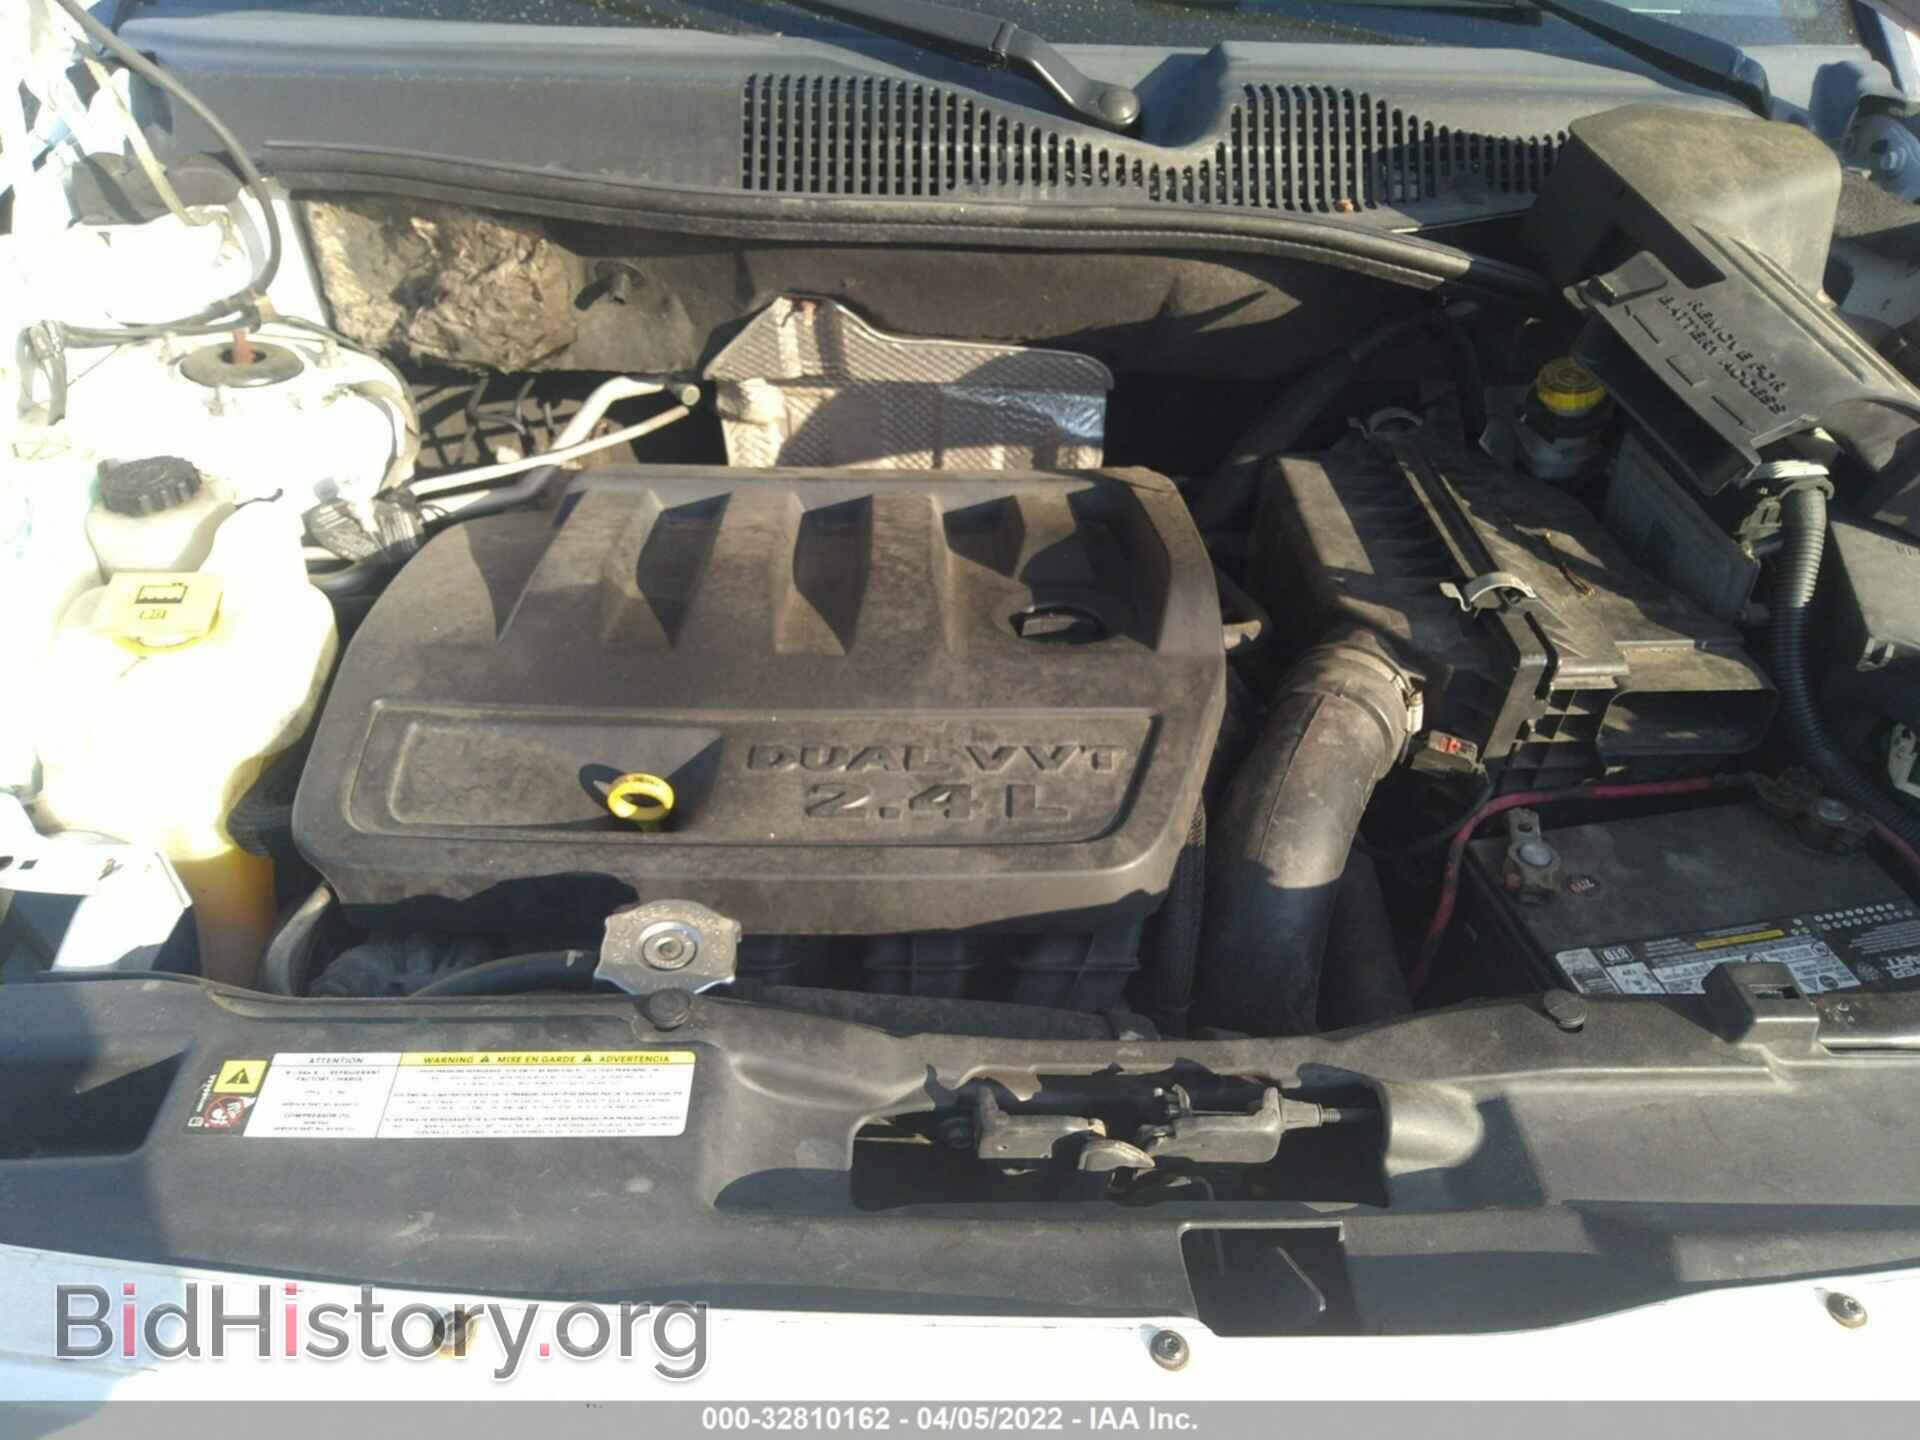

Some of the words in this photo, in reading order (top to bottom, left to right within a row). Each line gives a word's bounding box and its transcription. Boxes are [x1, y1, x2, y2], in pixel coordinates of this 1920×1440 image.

[746, 744, 953, 772] DUAL
[964, 744, 1128, 772] VVT
[309, 1056, 365, 1064] ATTENTION
[423, 1056, 474, 1064] WARNING
[497, 1056, 522, 1064] MISE
[542, 1055, 577, 1063] GARDE
[600, 1055, 671, 1063] ADVERTENCIA
